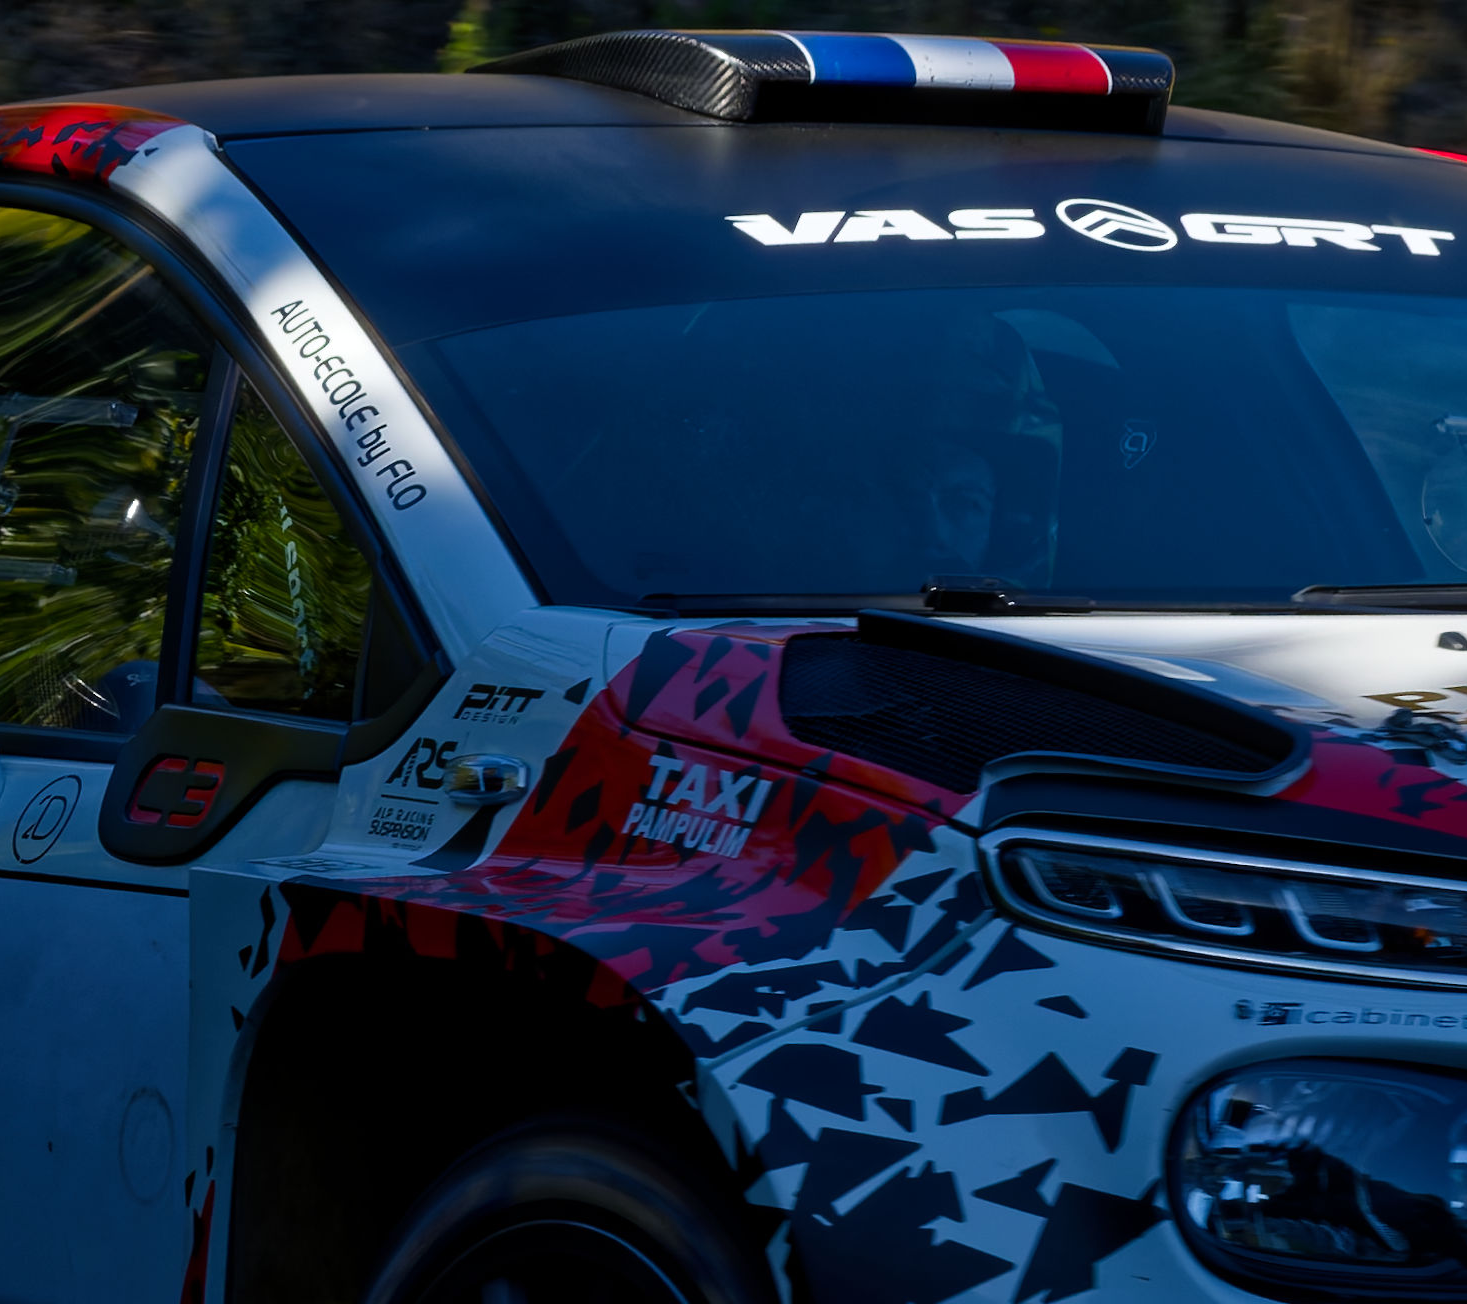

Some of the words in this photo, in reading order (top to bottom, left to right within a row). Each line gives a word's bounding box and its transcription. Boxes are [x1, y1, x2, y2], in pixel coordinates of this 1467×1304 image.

[724, 207, 1045, 246] VAS
[1179, 213, 1455, 257] GRT
[270, 299, 379, 432] AUTO-ECOLE
[357, 425, 390, 469] by
[374, 458, 427, 513] FLO
[461, 711, 520, 725] DESIGN
[133, 756, 226, 828] C3
[646, 754, 775, 825] TAXI
